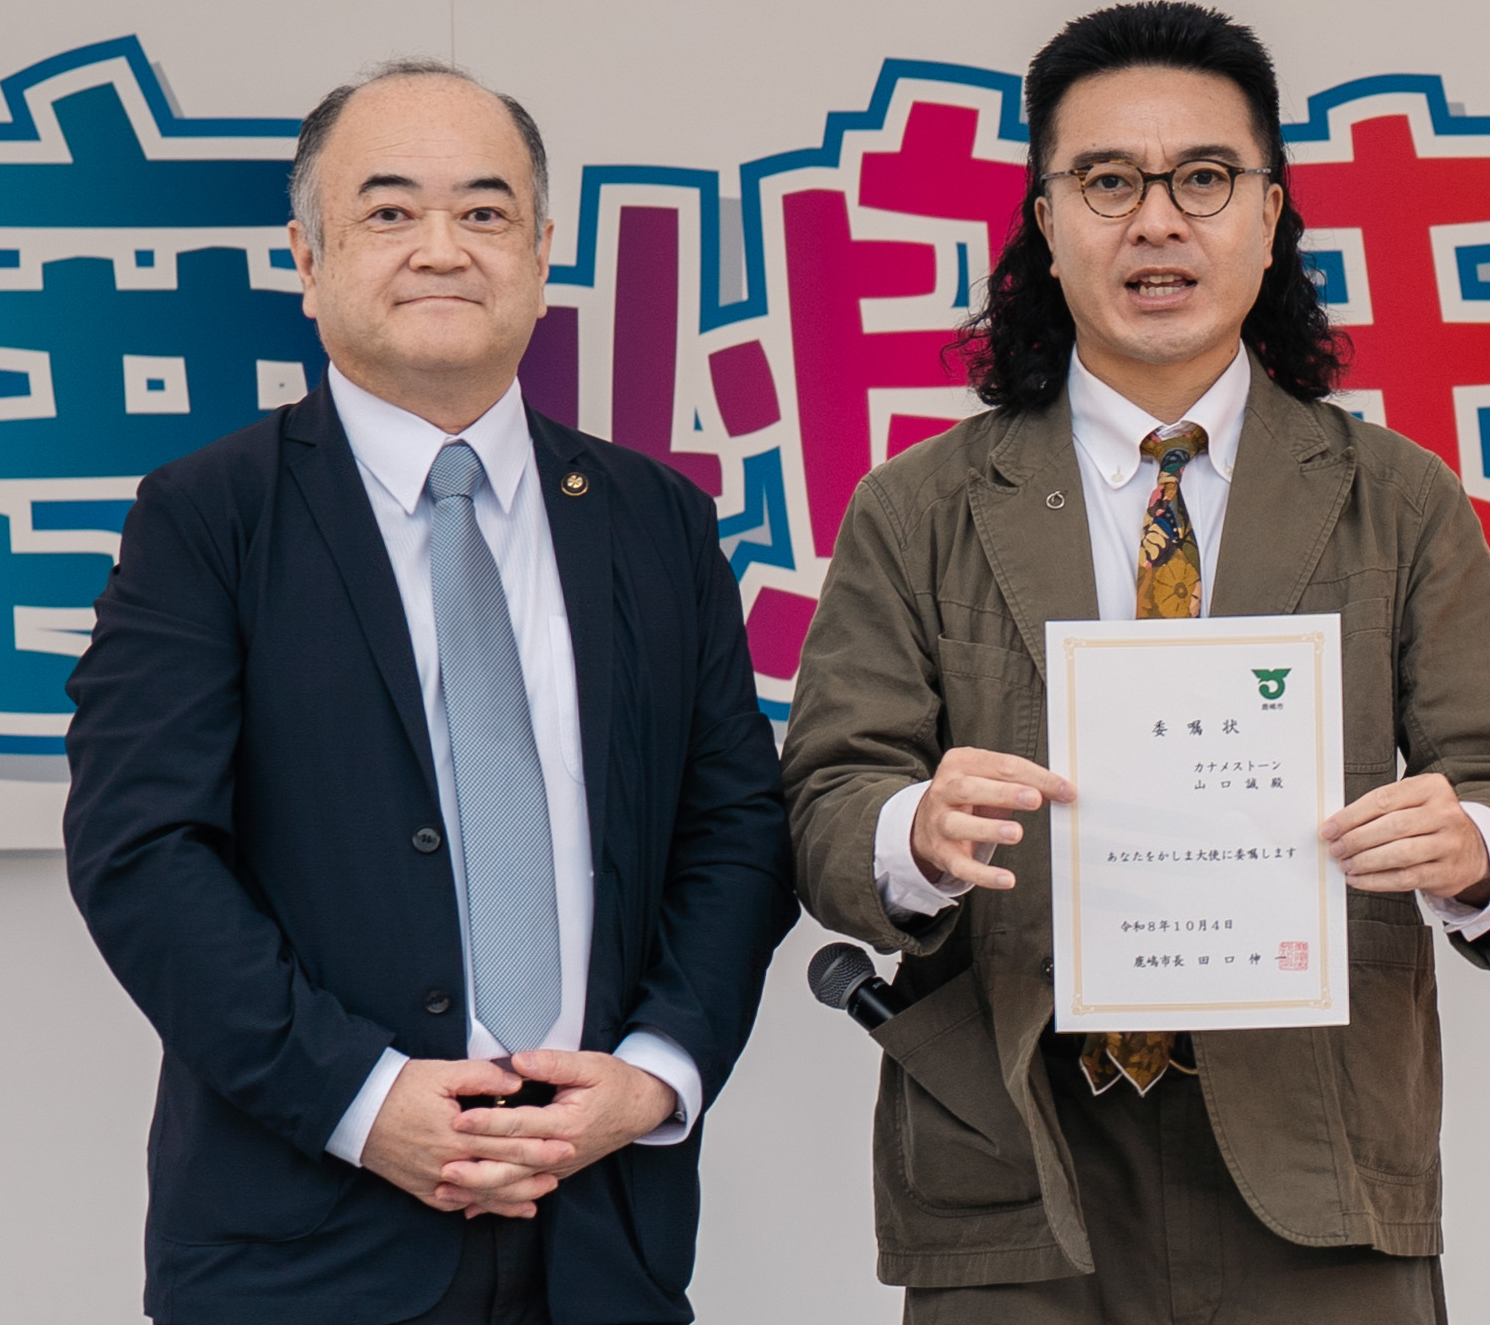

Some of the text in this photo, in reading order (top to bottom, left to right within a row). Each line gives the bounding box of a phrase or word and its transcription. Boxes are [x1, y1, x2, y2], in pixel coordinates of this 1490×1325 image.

[1194, 760, 1281, 773] カナメストーン
